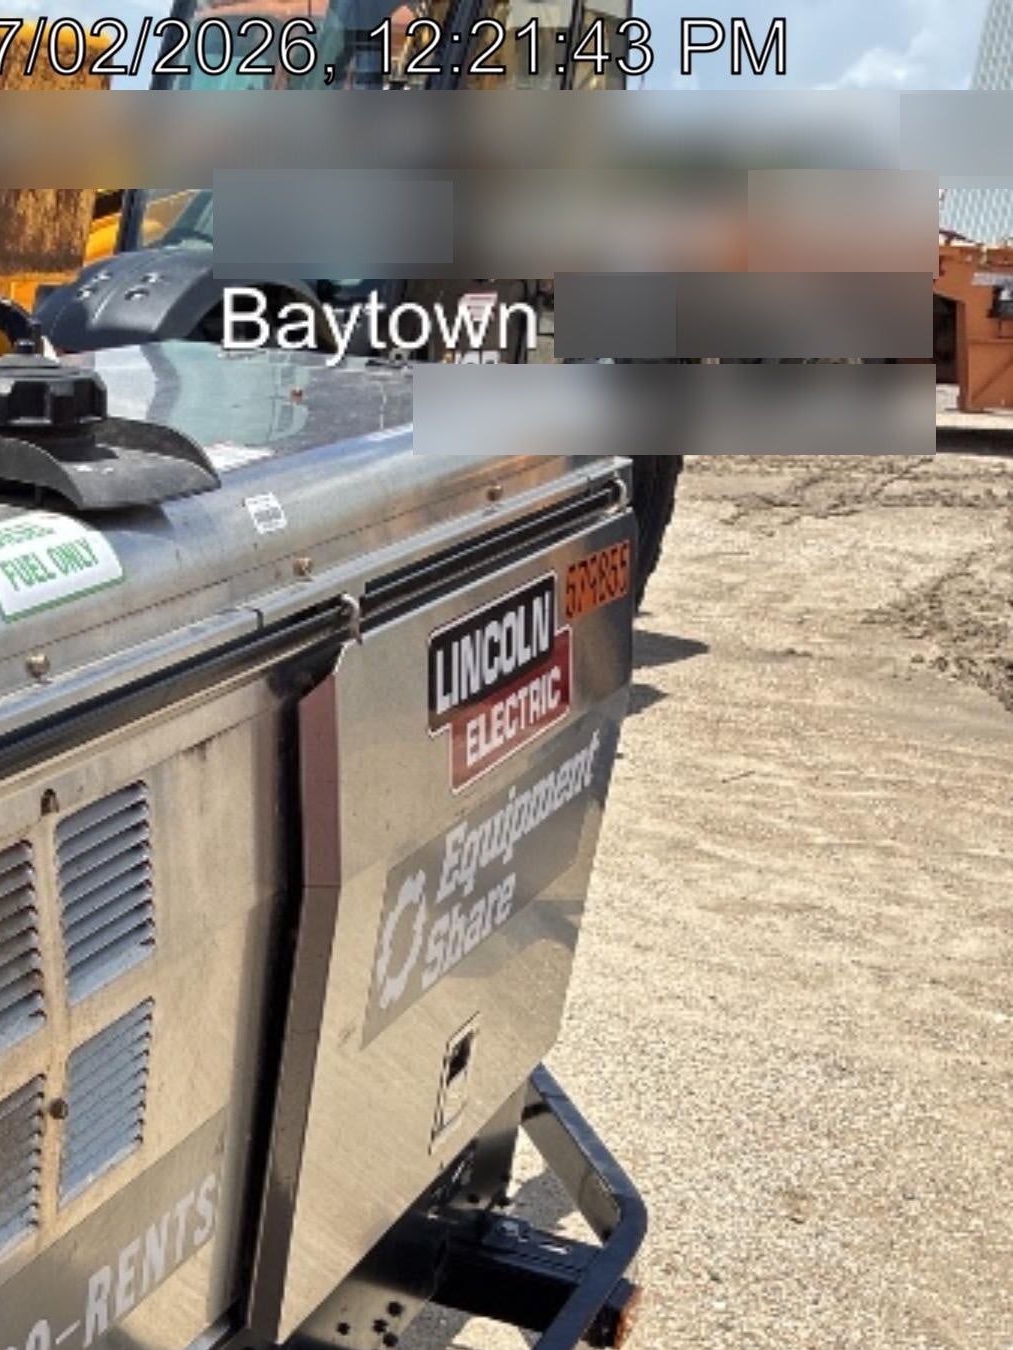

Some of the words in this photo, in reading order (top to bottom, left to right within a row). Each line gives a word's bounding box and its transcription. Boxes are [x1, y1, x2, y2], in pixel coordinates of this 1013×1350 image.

[0, 552, 56, 592] FUEL
[47, 537, 99, 577] ONLY
[437, 591, 550, 715] LINCOLN
[467, 666, 561, 767] ELECTRIC
[437, 729, 601, 904] Equipment
[421, 872, 517, 990] Share
